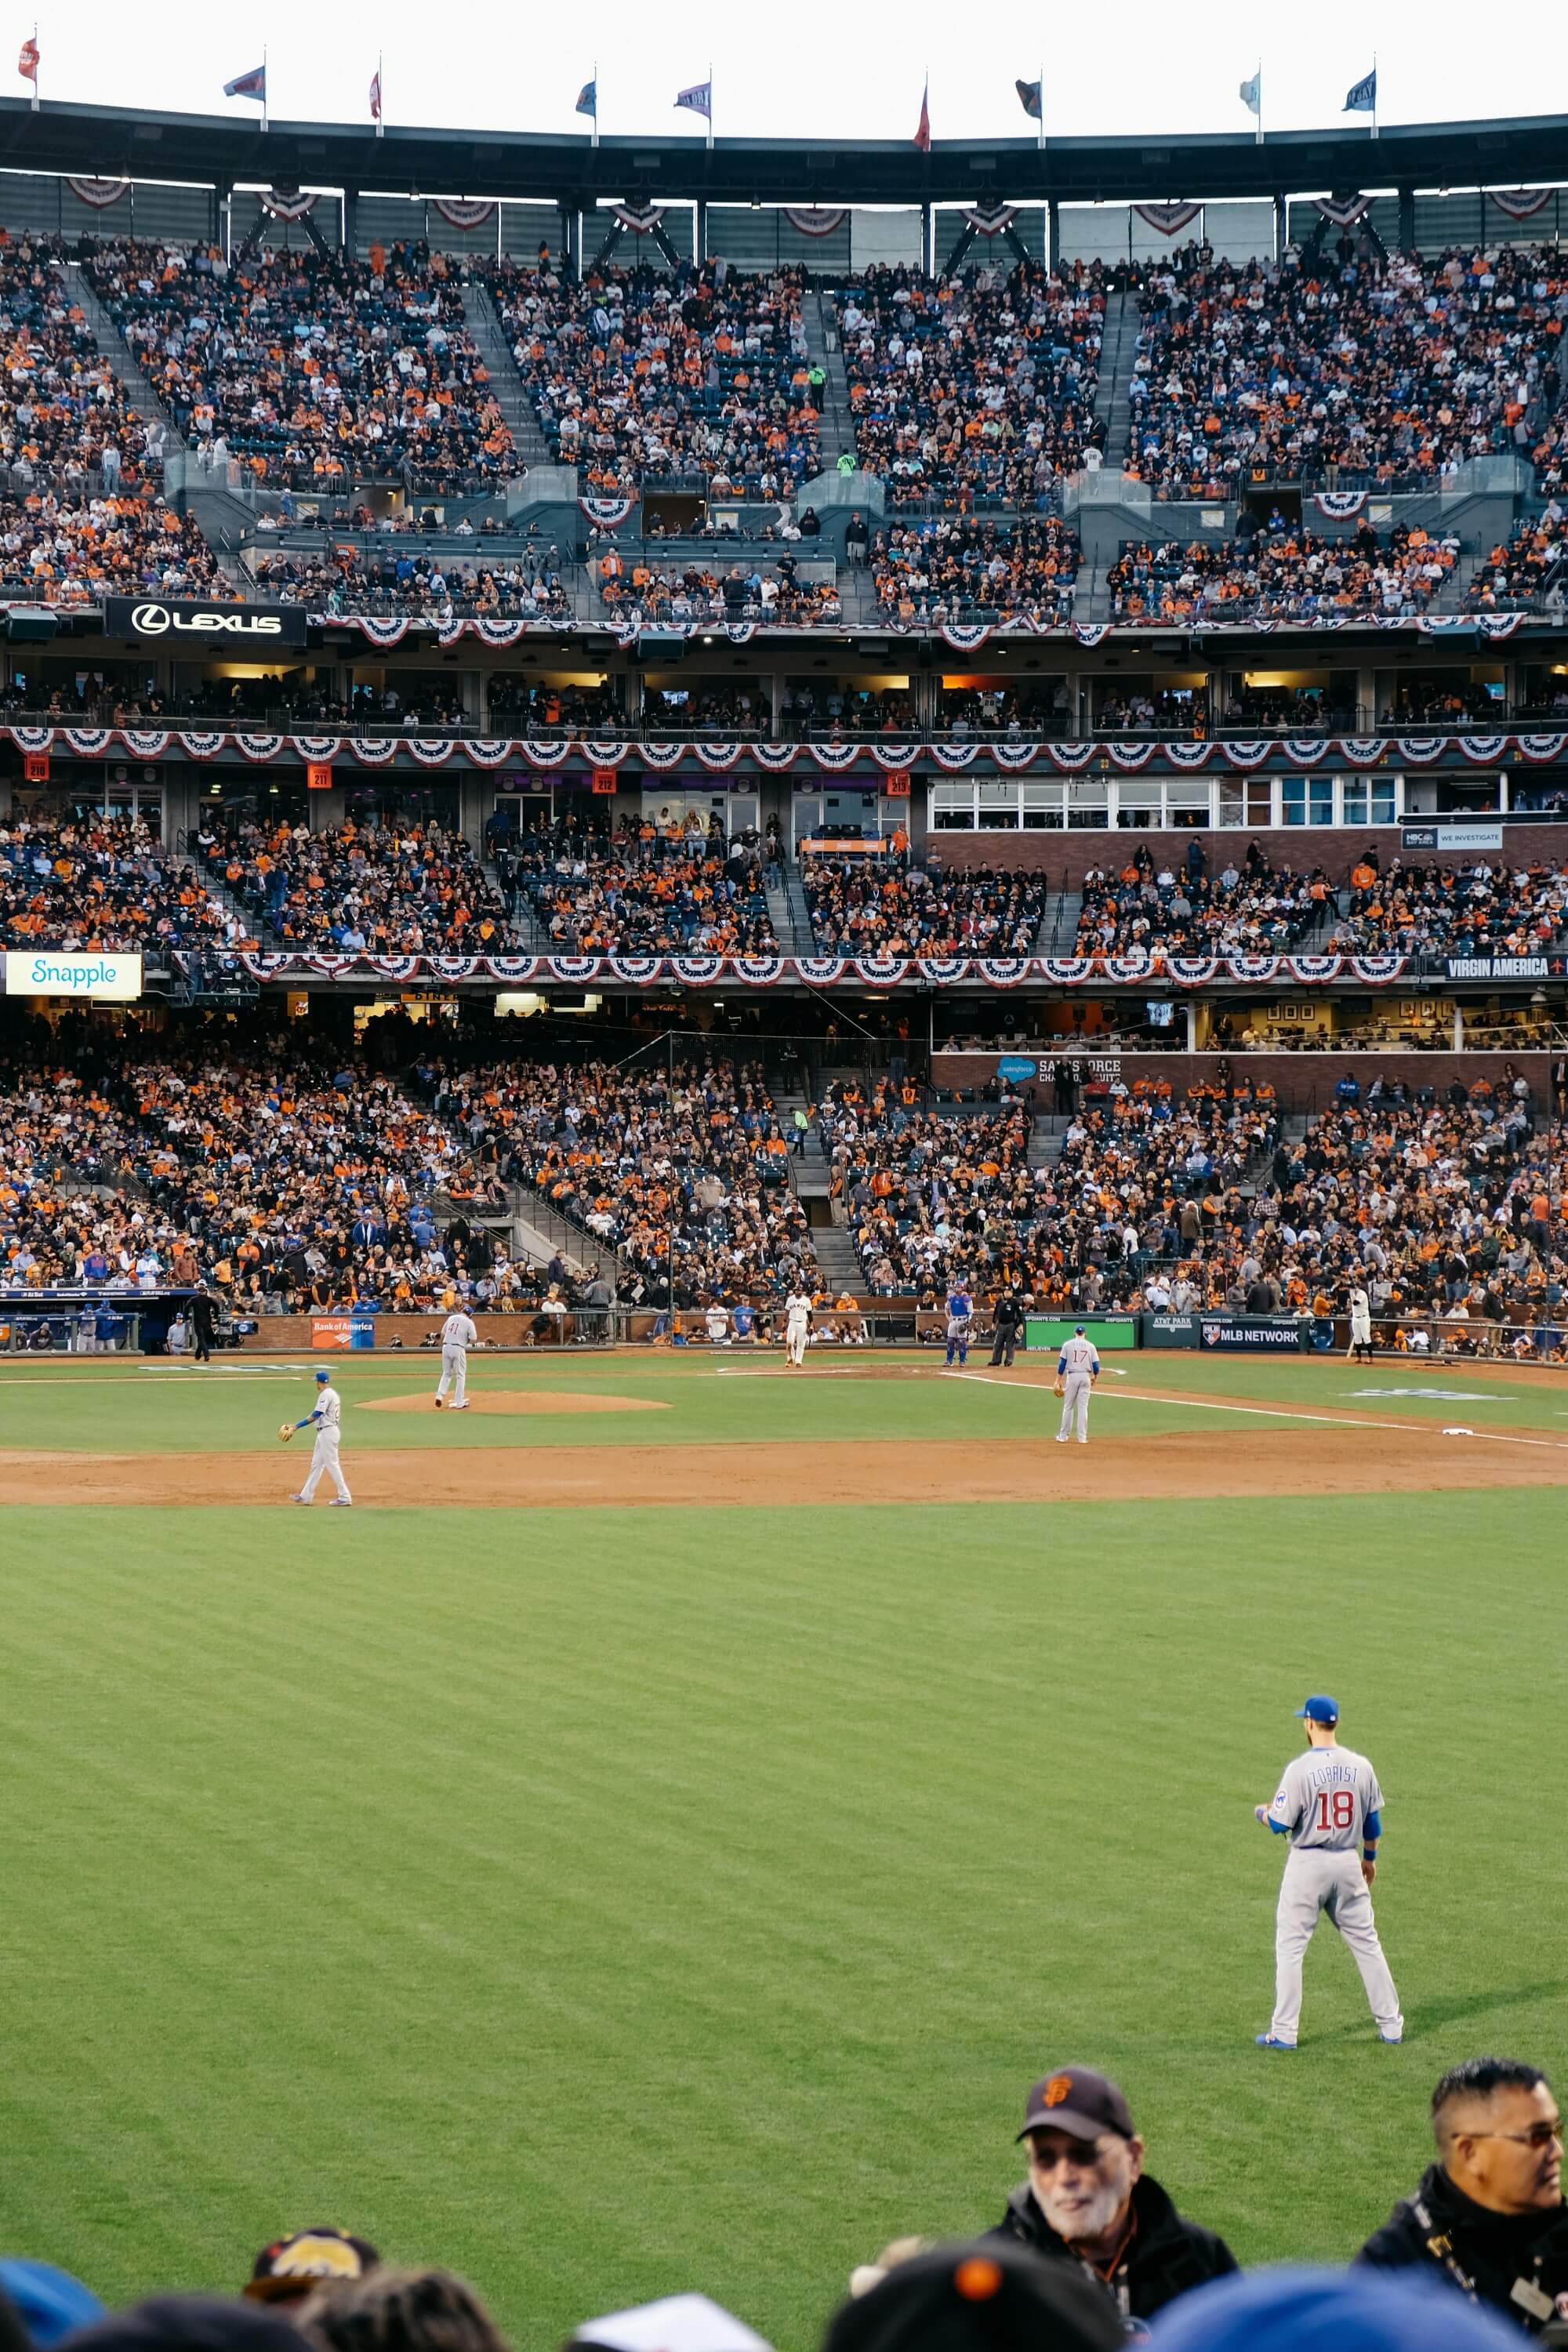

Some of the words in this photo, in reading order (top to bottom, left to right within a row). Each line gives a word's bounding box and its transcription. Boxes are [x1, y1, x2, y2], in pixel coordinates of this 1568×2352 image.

[172, 612, 282, 634] LEXUS
[31, 765, 45, 777] 210
[314, 775, 327, 785] 211
[598, 780, 612, 790] 212
[1449, 959, 1490, 977] VIRGIN
[1493, 958, 1549, 976] AMERICA
[31, 960, 116, 989] Snapple
[1040, 1060, 1121, 1073] SASORCE
[448, 1323, 459, 1334] 41
[1221, 1330, 1243, 1341] MLB
[1245, 1330, 1298, 1343] NETWORK
[1073, 1349, 1088, 1363] 17
[1309, 1766, 1358, 1788] ZOBRIST
[1316, 1791, 1354, 1831] 18
